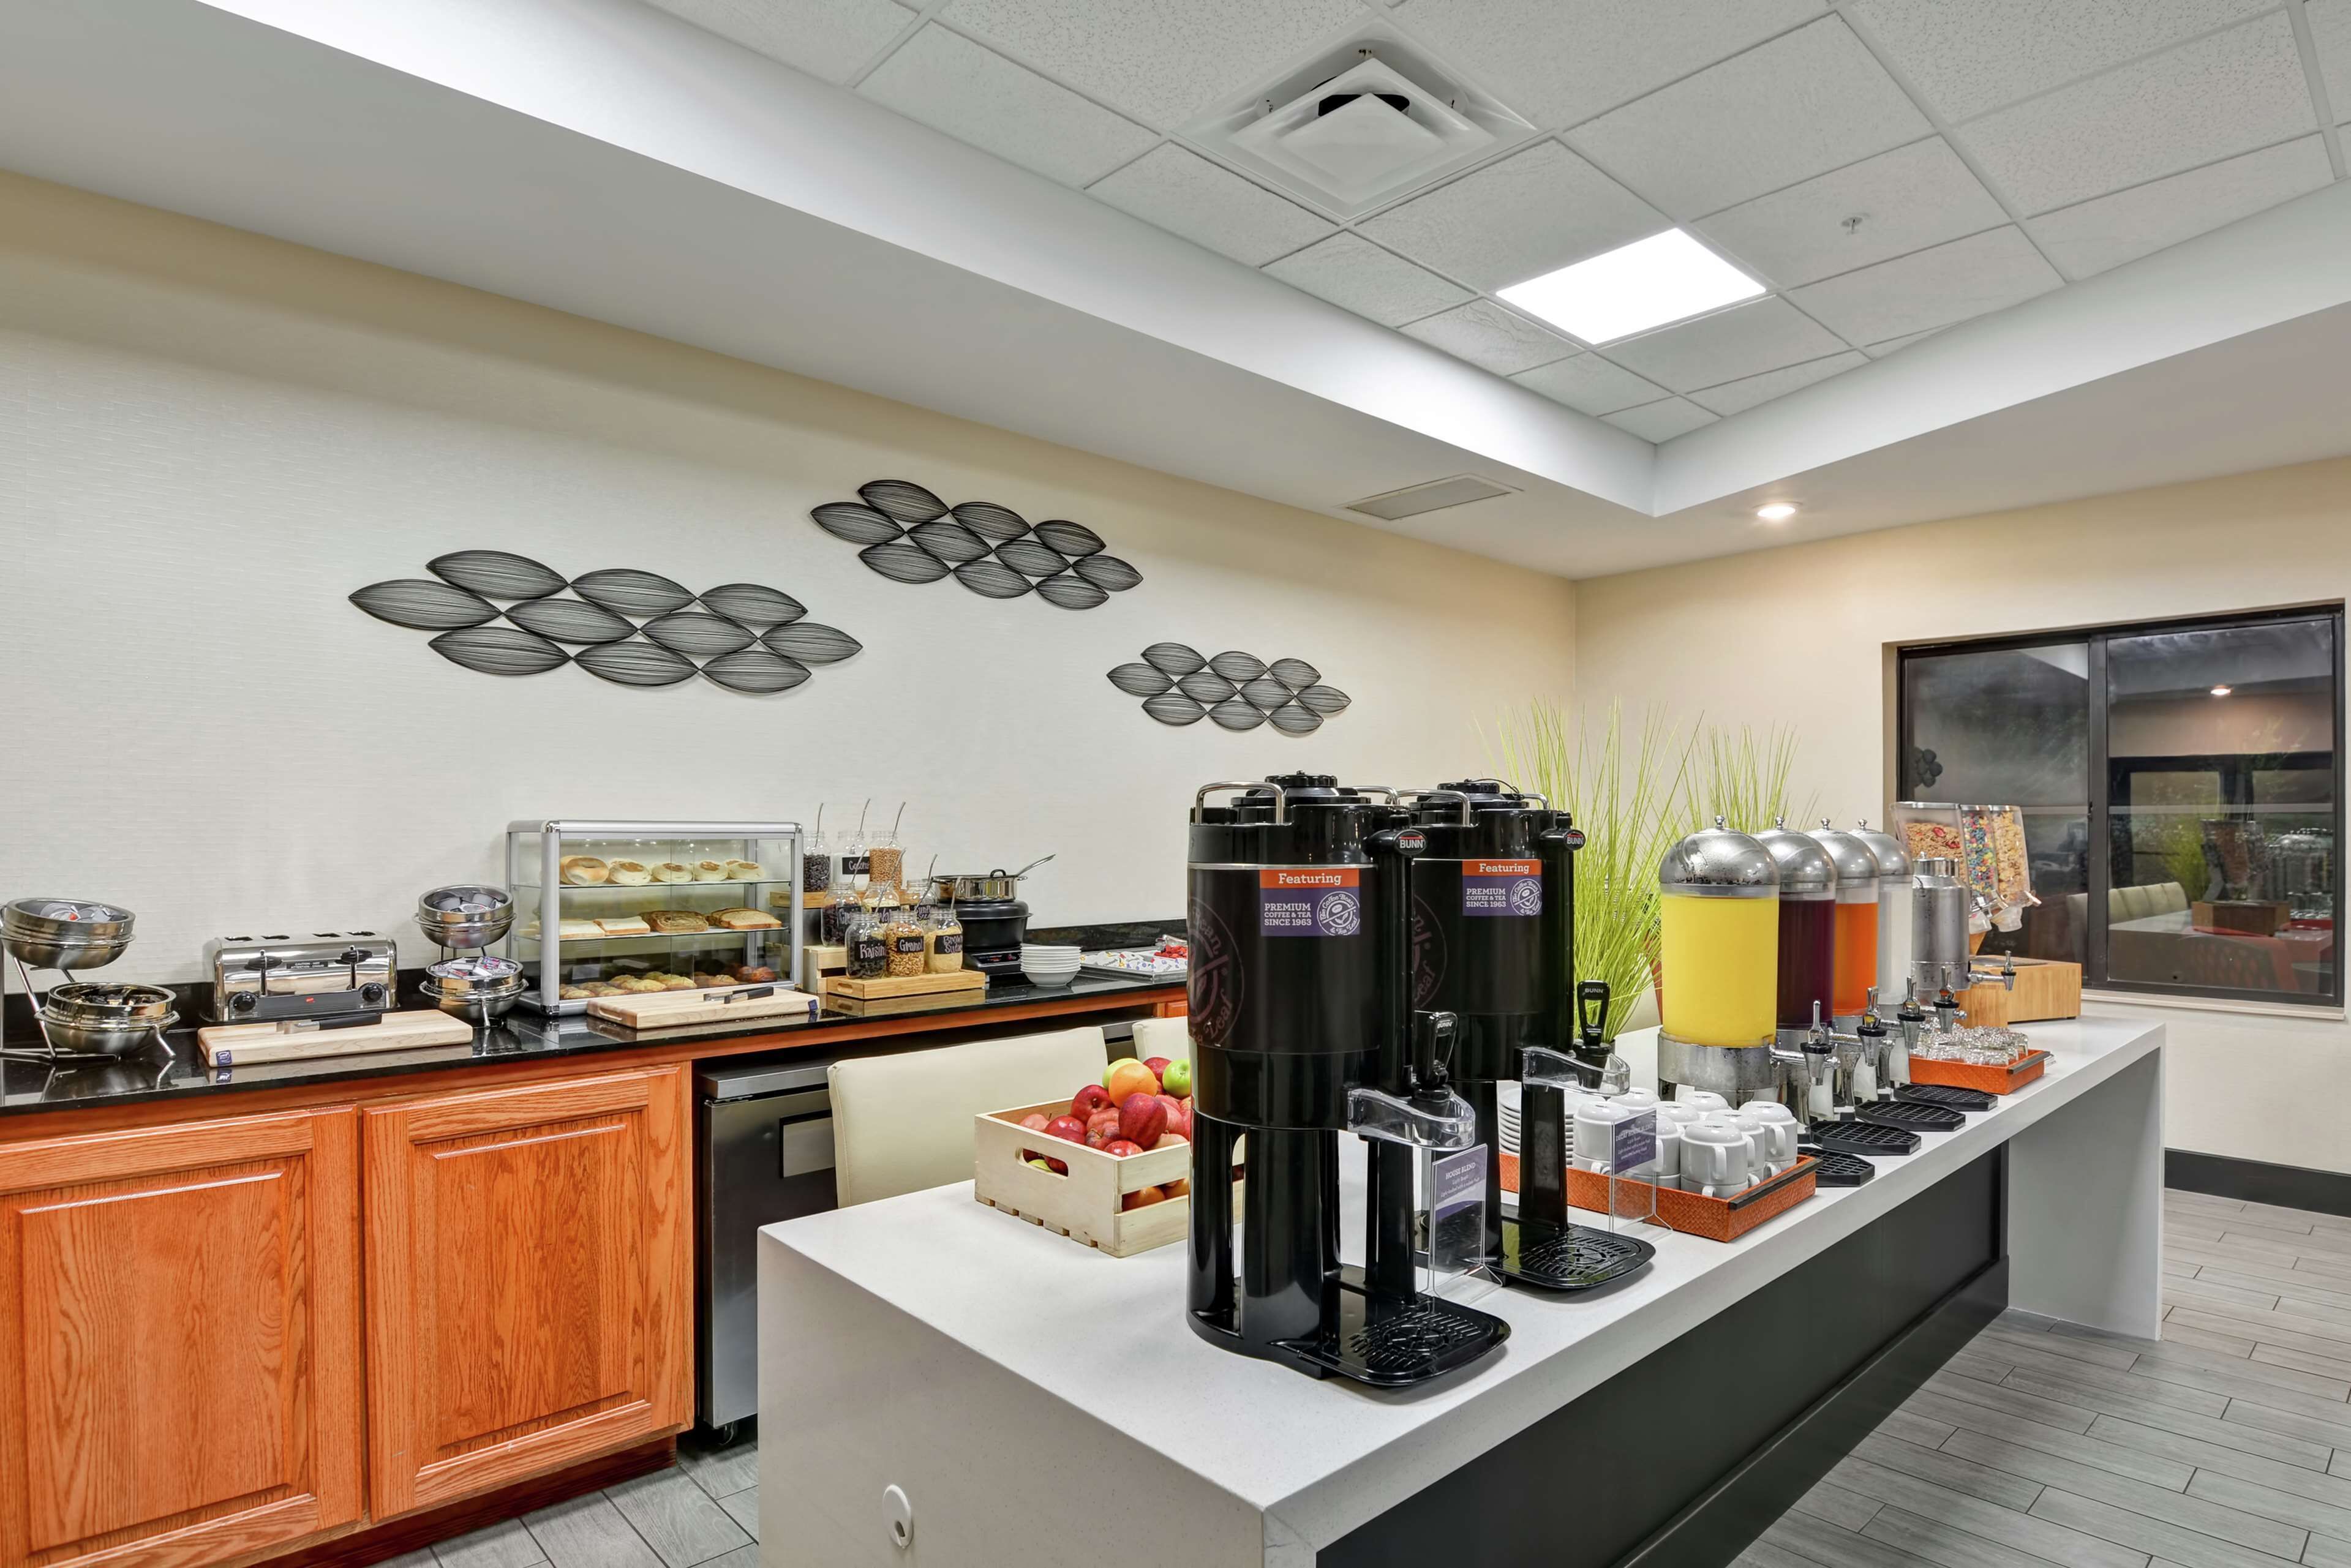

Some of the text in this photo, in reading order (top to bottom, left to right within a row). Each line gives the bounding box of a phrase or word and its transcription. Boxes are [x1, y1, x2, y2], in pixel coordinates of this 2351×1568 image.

[1399, 839, 1423, 849] BUNN
[1567, 836, 1584, 845] BUNN
[1479, 863, 1530, 874] Featuring
[1278, 873, 1342, 885] Featuring
[1322, 895, 1339, 909] Coffee
[1339, 893, 1354, 907] Bean
[1445, 1162, 1476, 1180] HOUSE BLEND
